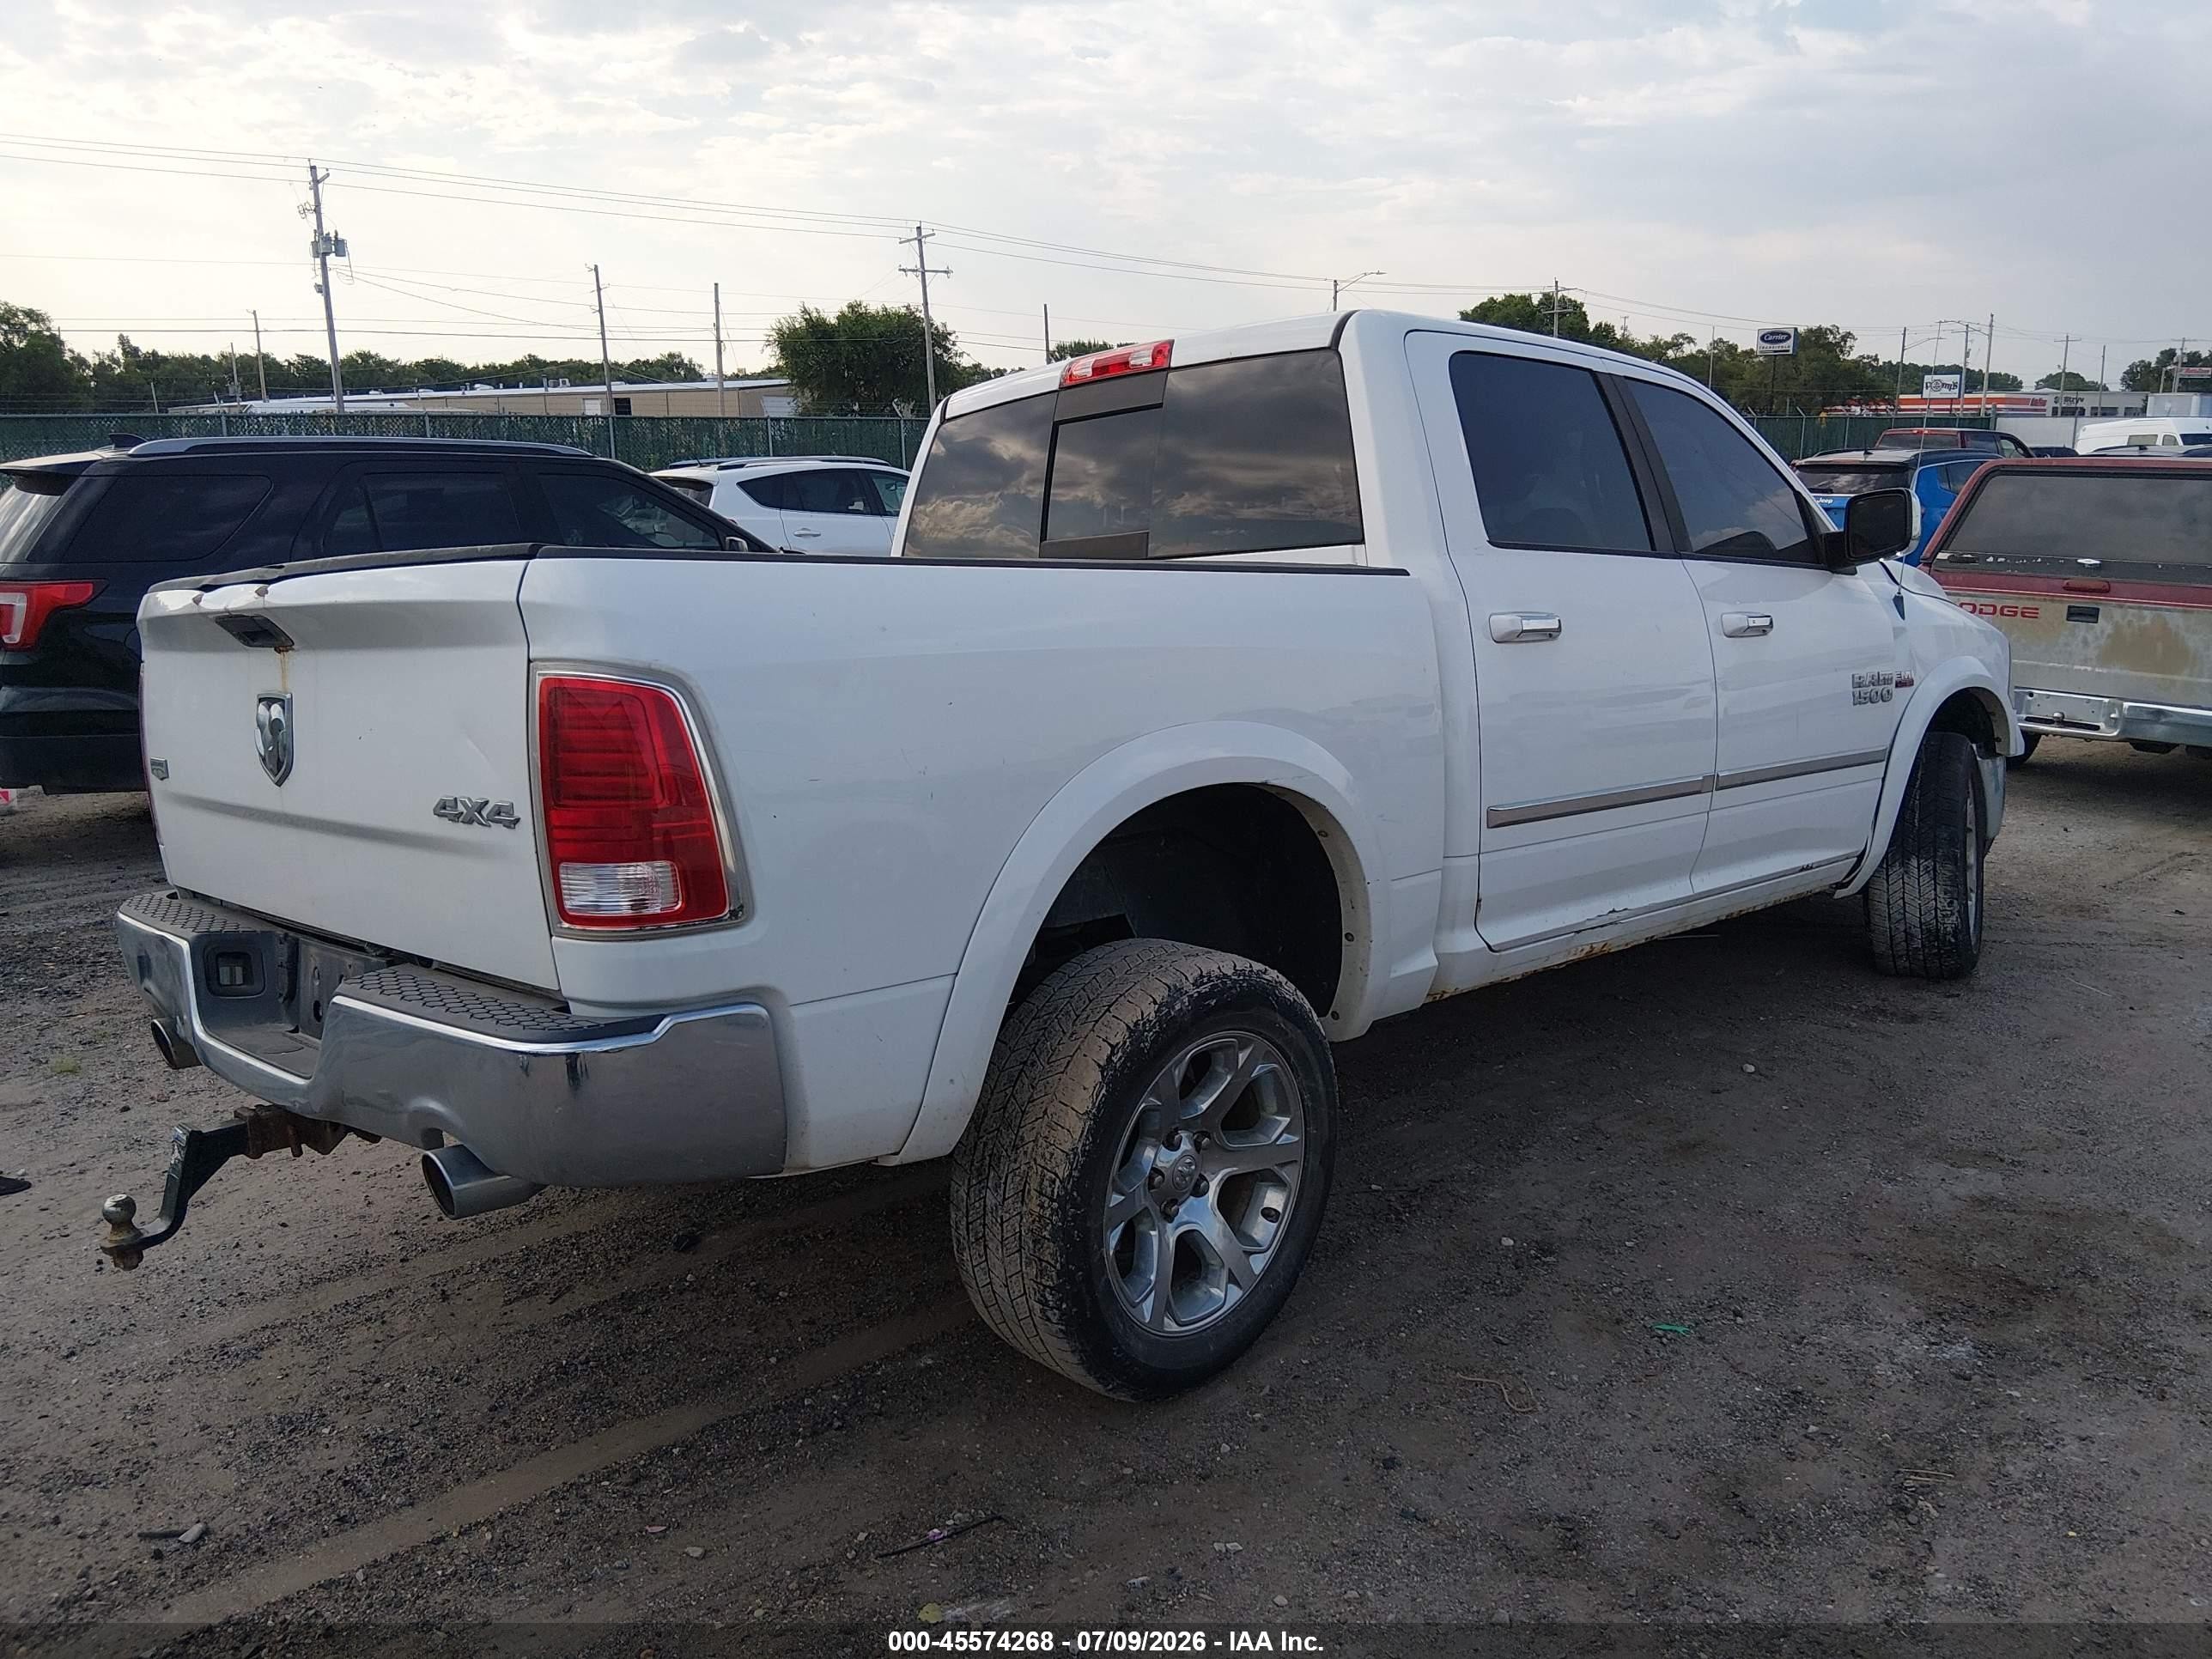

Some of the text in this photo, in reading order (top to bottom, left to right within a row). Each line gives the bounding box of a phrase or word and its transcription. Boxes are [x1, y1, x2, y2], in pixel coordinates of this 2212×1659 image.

[1959, 602, 2039, 619] ODGE
[1851, 672, 1893, 689] RAM
[1851, 687, 1893, 707] 1500
